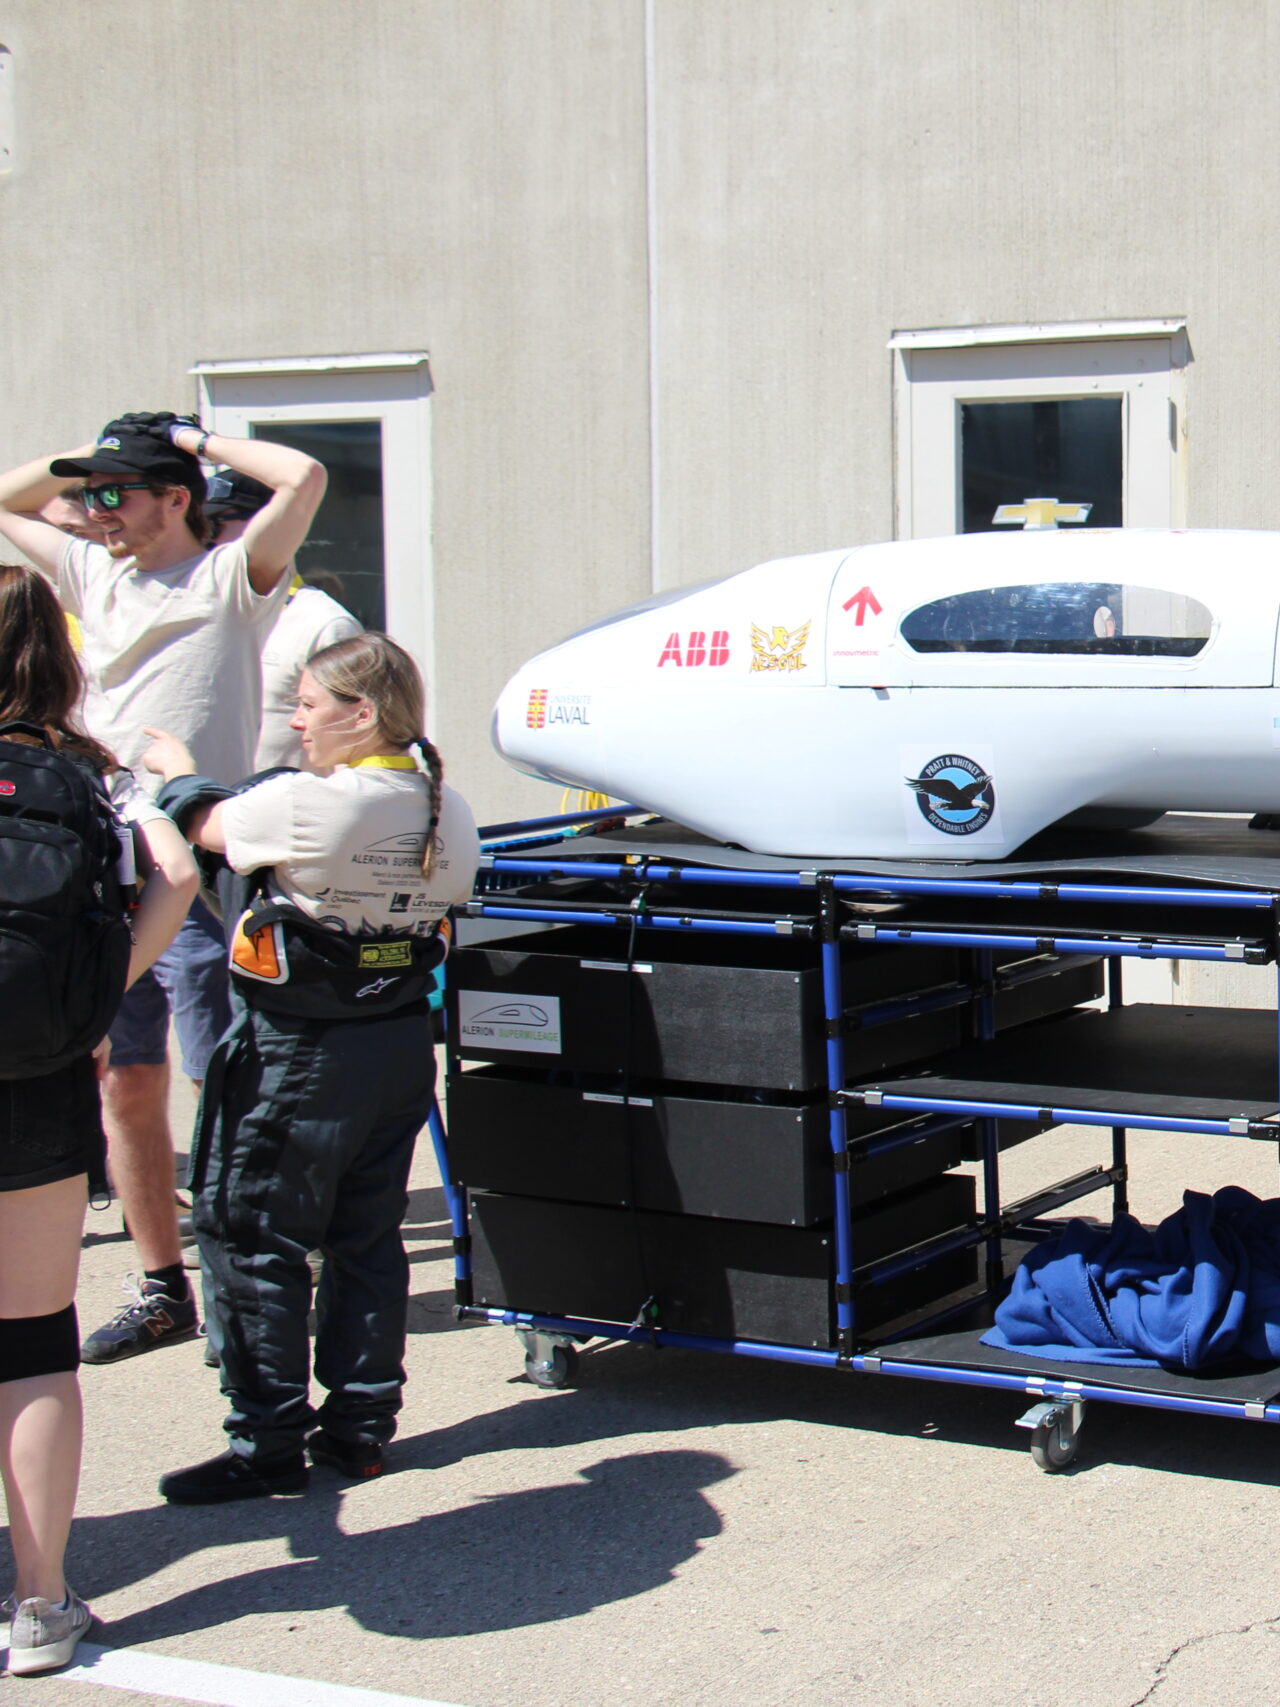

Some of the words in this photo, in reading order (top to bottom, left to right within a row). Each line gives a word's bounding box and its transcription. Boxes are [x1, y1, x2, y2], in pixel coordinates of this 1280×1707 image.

[656, 630, 731, 668] ABB
[548, 705, 591, 725] LAVAL
[925, 758, 945, 776] PRATT
[945, 757, 952, 766] &
[952, 757, 981, 776] WHITNEY
[927, 812, 966, 833] DEPENDABLE
[965, 812, 988, 832] ENGINES
[351, 854, 388, 866] ALERION
[462, 1025, 495, 1037] ALERION
[497, 1028, 559, 1042] SUPERMILEAGE
